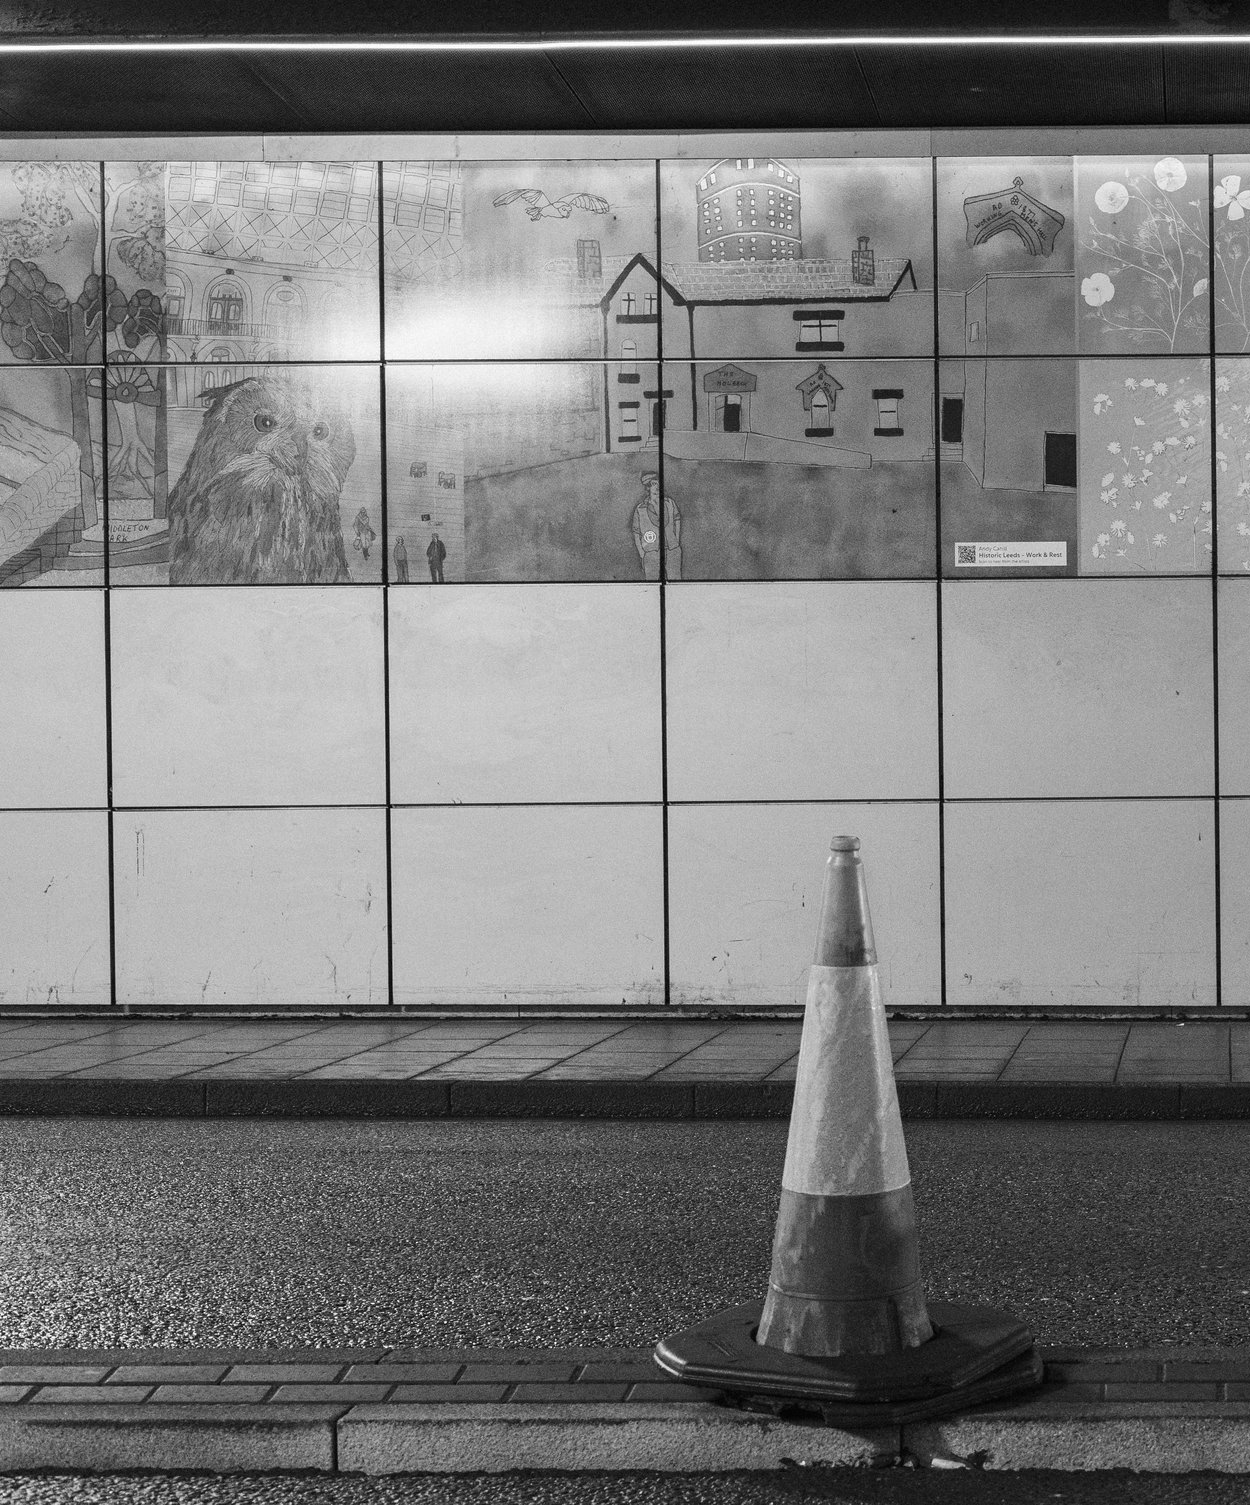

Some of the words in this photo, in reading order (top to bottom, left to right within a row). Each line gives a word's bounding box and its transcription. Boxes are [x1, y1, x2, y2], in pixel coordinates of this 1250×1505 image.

[974, 210, 1002, 229] WORKING
[110, 523, 150, 533] IDDLETON
[110, 534, 129, 542] ARK
